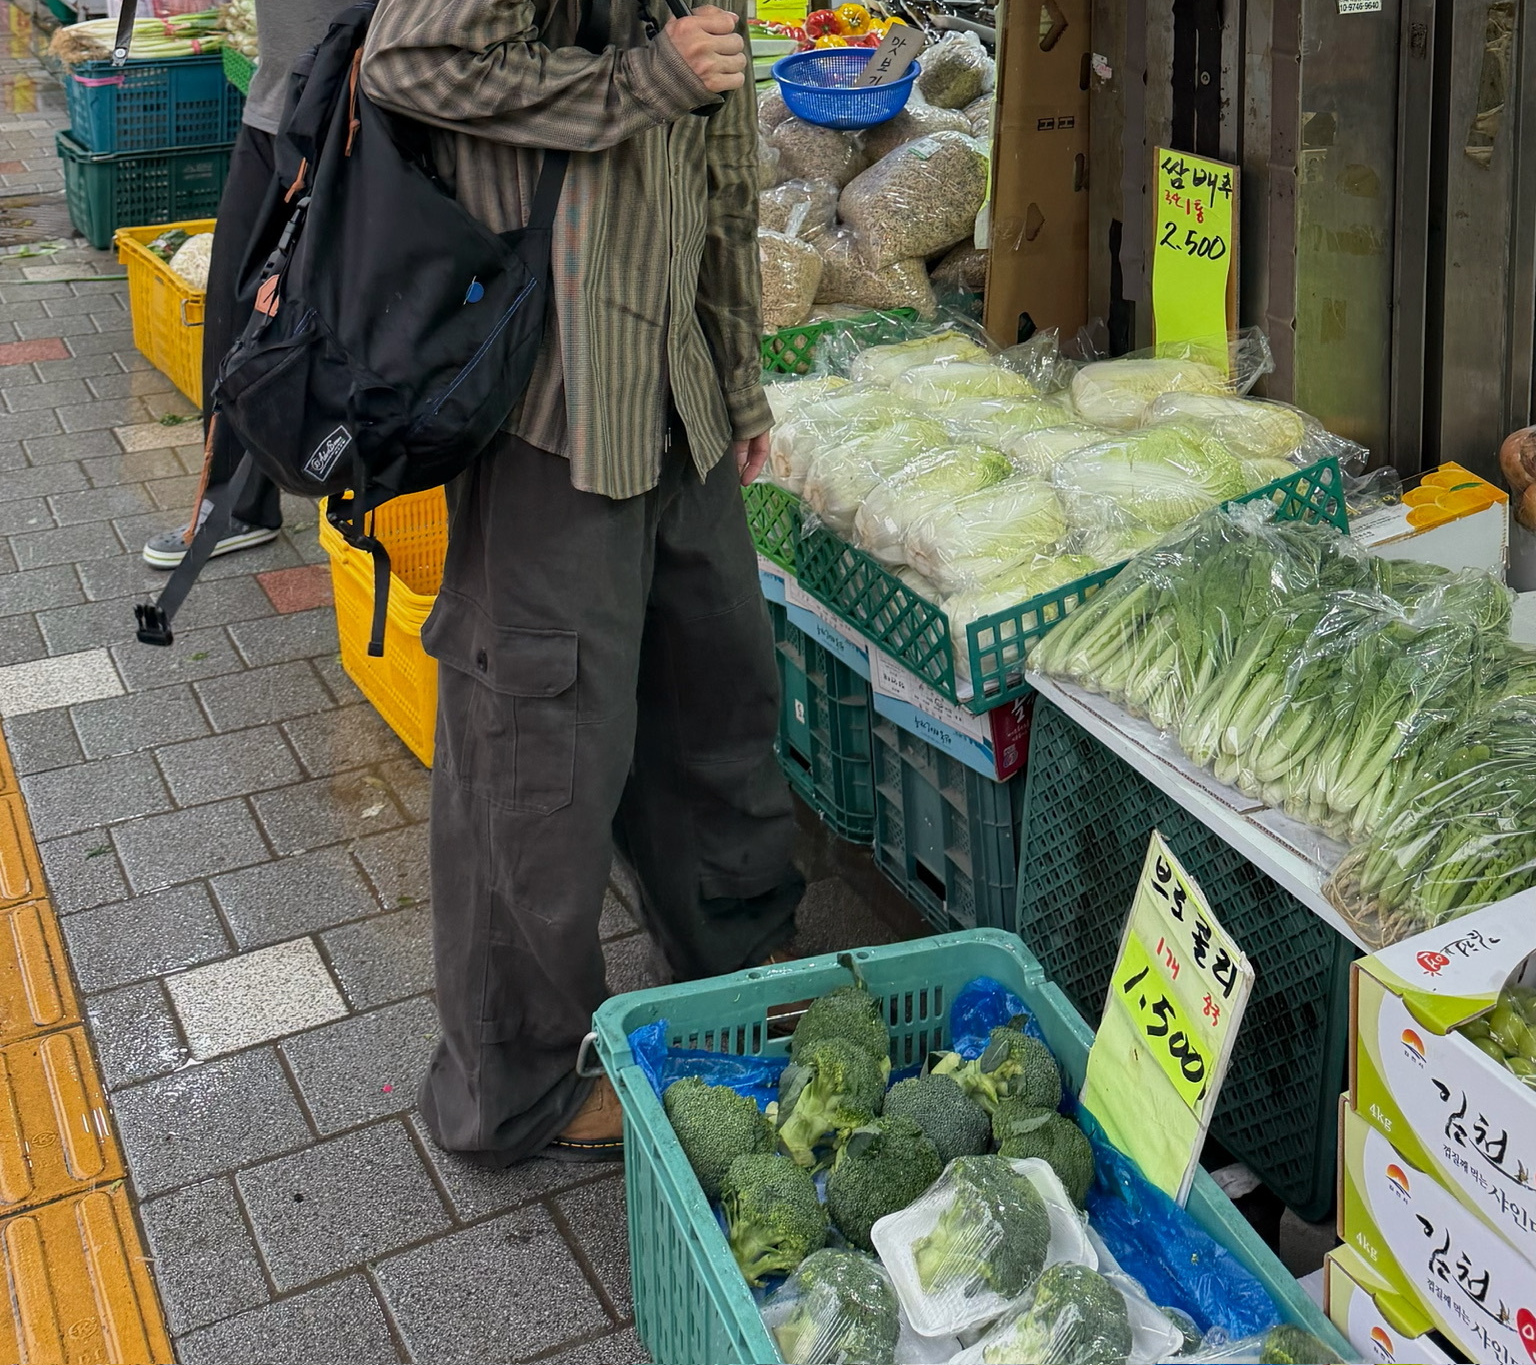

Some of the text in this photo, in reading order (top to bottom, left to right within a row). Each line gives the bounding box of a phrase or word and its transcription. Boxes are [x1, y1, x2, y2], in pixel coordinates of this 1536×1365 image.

[1161, 156, 1233, 208] 쌈배추
[1159, 221, 1227, 261] 2.500
[1151, 853, 1240, 1000] 브로콜리
[1123, 964, 1206, 1085] 1.500
[1369, 1102, 1393, 1133] 4kg
[1431, 1078, 1508, 1165] 김천
[1471, 1165, 1489, 1190] 먹는
[1356, 1231, 1379, 1263] 4kg
[1415, 1213, 1491, 1303] 김천
[1453, 1301, 1471, 1326] 먹는
